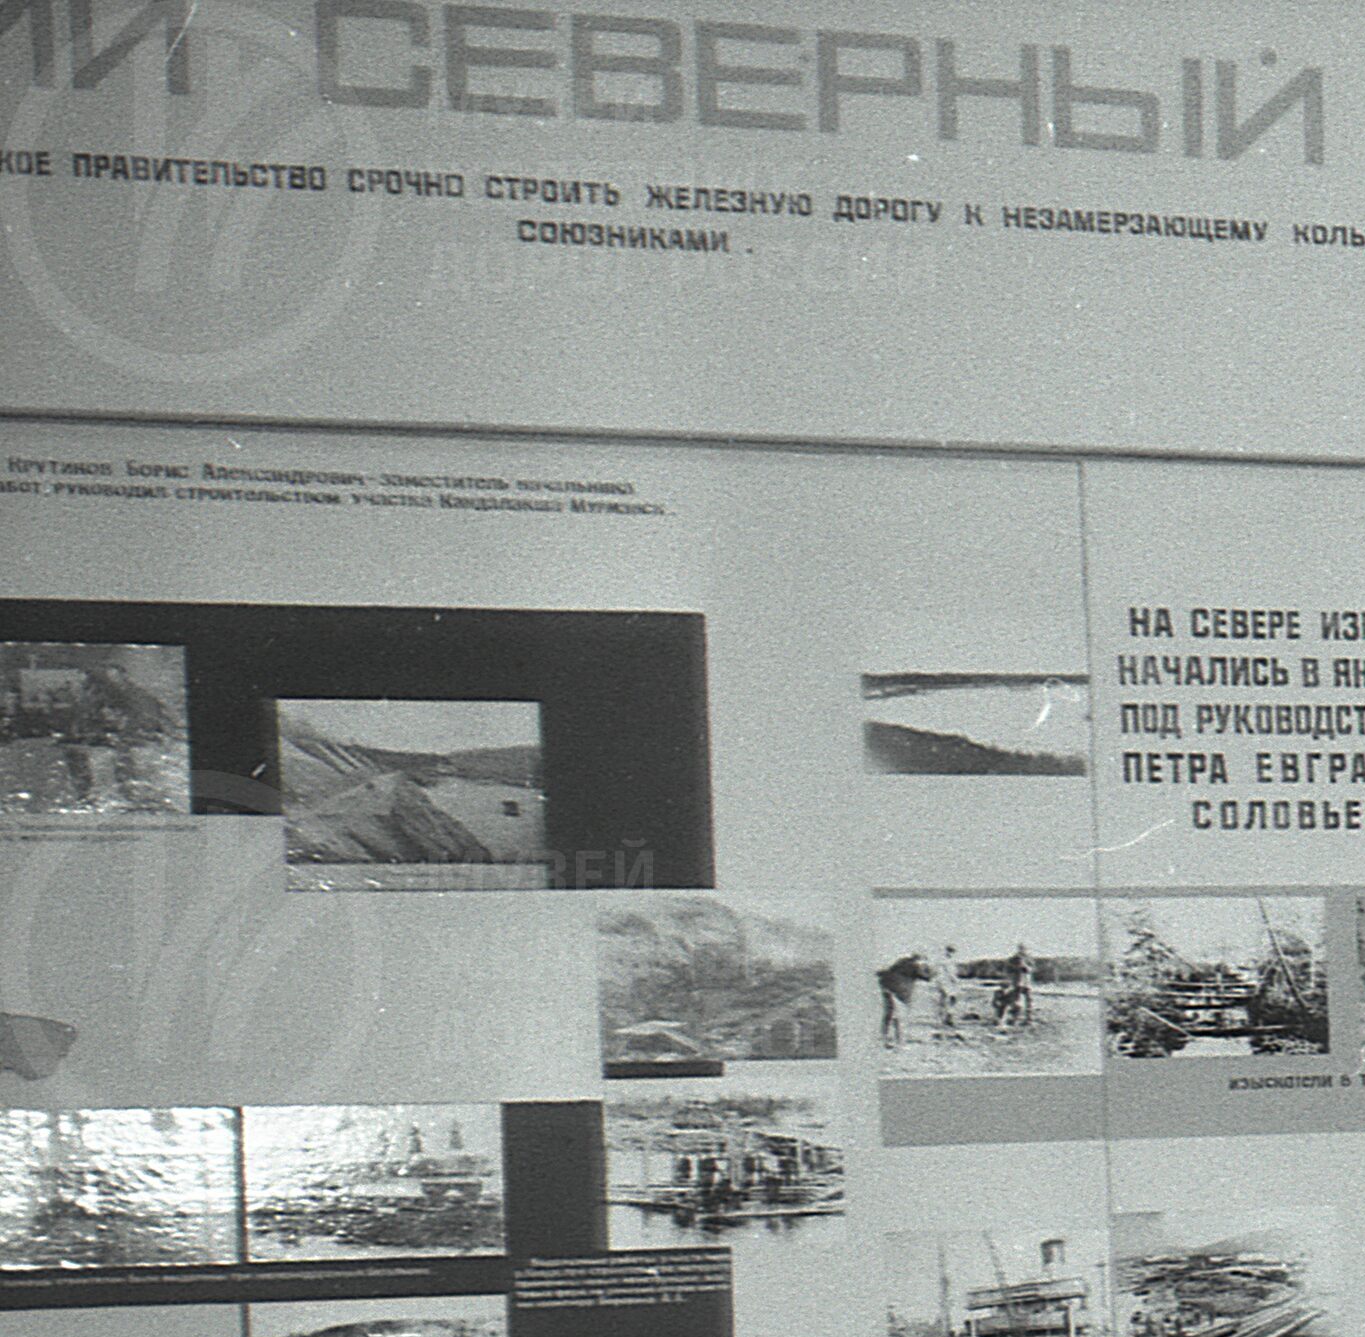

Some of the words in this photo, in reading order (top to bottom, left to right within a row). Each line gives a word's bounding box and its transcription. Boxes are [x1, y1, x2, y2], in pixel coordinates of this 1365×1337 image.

[316, 3, 1325, 167] СЕВЕРНЫЙ
[72, 151, 327, 192] ПРАВИТЕЛЬСТВО
[348, 169, 464, 199] СРОЧНО
[485, 176, 621, 208] СТРОИТЬ
[646, 184, 813, 218] ЖЕЛЕЗНУЮ
[832, 192, 942, 227] ДОРОГУ
[964, 203, 984, 227] К
[1003, 204, 1268, 245] НЕЗАМЕРЗАЮЩЕМУ
[1129, 607, 1174, 640] НА
[1189, 607, 1302, 641] СЕВЕРЕ
[1117, 654, 1290, 687] НАЧАЛИСЬ
[1300, 657, 1320, 688] В
[1120, 703, 1182, 739] ПОД
[1122, 751, 1228, 784] ПЕТРА
